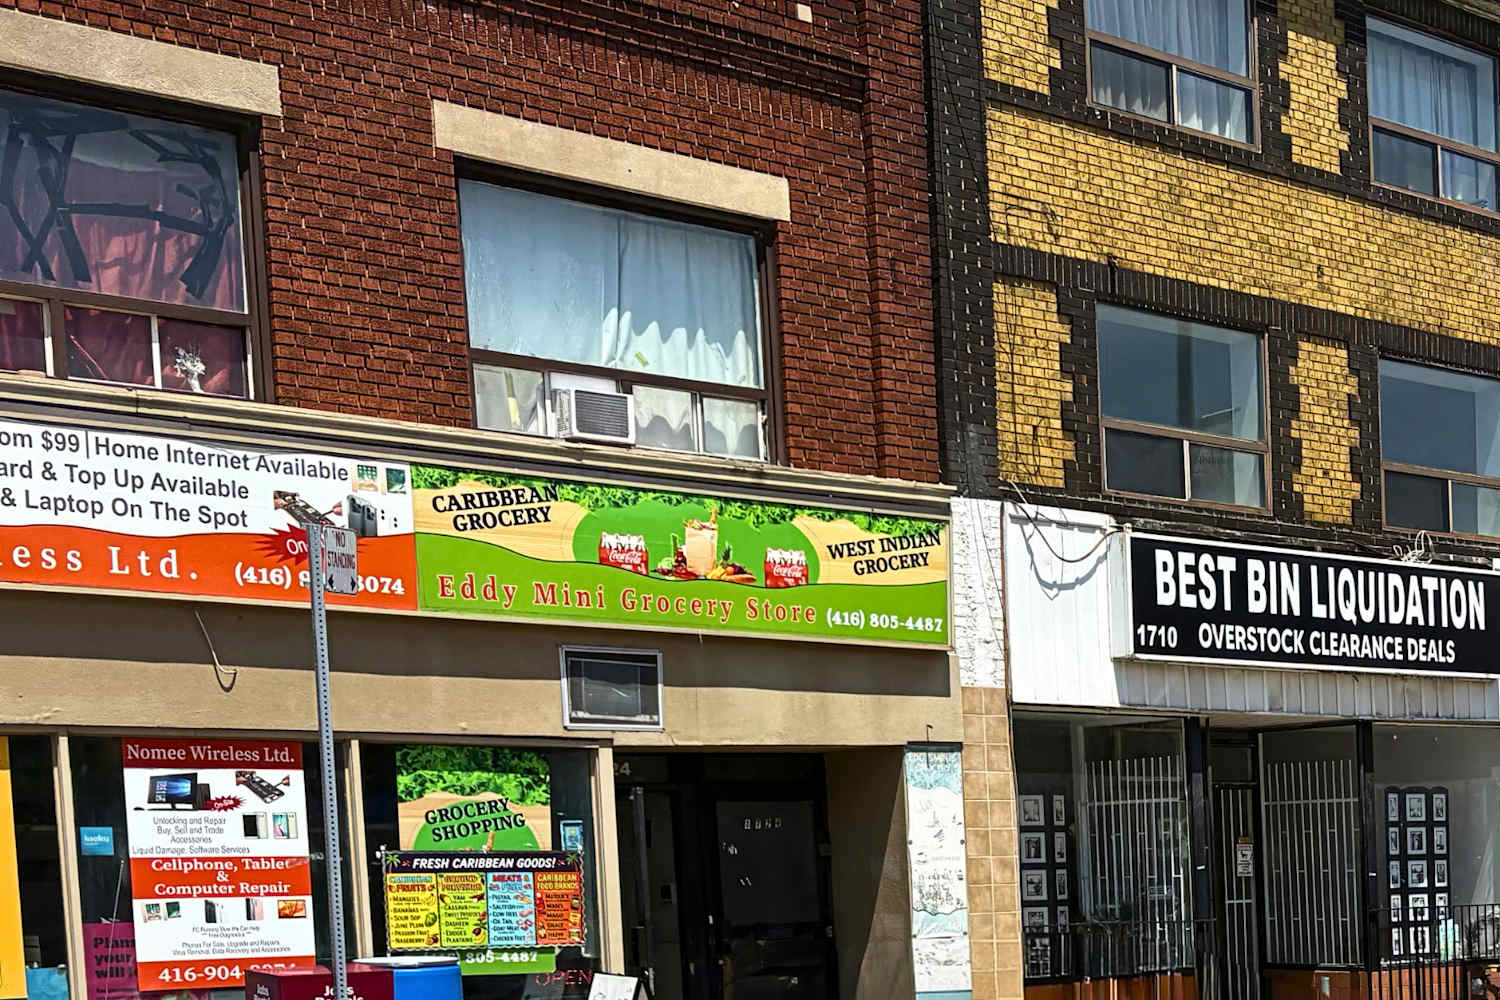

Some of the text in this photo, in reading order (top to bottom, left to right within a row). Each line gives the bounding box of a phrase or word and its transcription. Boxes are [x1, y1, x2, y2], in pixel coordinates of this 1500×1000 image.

[41, 430, 80, 453] $99
[95, 436, 348, 481] Home Internet Available
[41, 461, 57, 481] &
[64, 463, 106, 490] Top
[113, 468, 144, 493] Up
[150, 472, 249, 500] Available
[1, 487, 249, 530] & Laptop On The Spot
[432, 484, 559, 513] CARIBBEAN
[452, 506, 551, 532] GROCERY
[334, 531, 346, 548] NO
[826, 530, 942, 560] WEST INDIAN
[0, 545, 199, 580] ess Ltd.
[326, 552, 356, 570] STANDING
[853, 551, 930, 576] GROCERY
[234, 561, 291, 590] (416)
[1155, 549, 1486, 631] BEST BIN LIQUIDATION
[437, 574, 943, 633] Eddy Mini Grocery Store (416) 805-4487
[1136, 623, 1456, 664] 1710 OVERSTOCK CLEARANCE DEALS
[126, 743, 295, 763] Nomee Wireless Ltd.
[153, 816, 226, 828] Unlocking and Repair
[424, 798, 511, 826] GROCERY
[204, 825, 224, 835] Trade
[432, 813, 527, 842] SHOPPING
[189, 844, 219, 854] Software
[151, 858, 238, 873] Cellphone,
[412, 857, 556, 869] FRESH CARIBBEAN GOODS!
[216, 871, 229, 882] &
[154, 881, 291, 898] Computer Repair
[94, 955, 132, 967] your
[465, 952, 538, 964] 805-4487
[535, 969, 592, 985] OPEN
